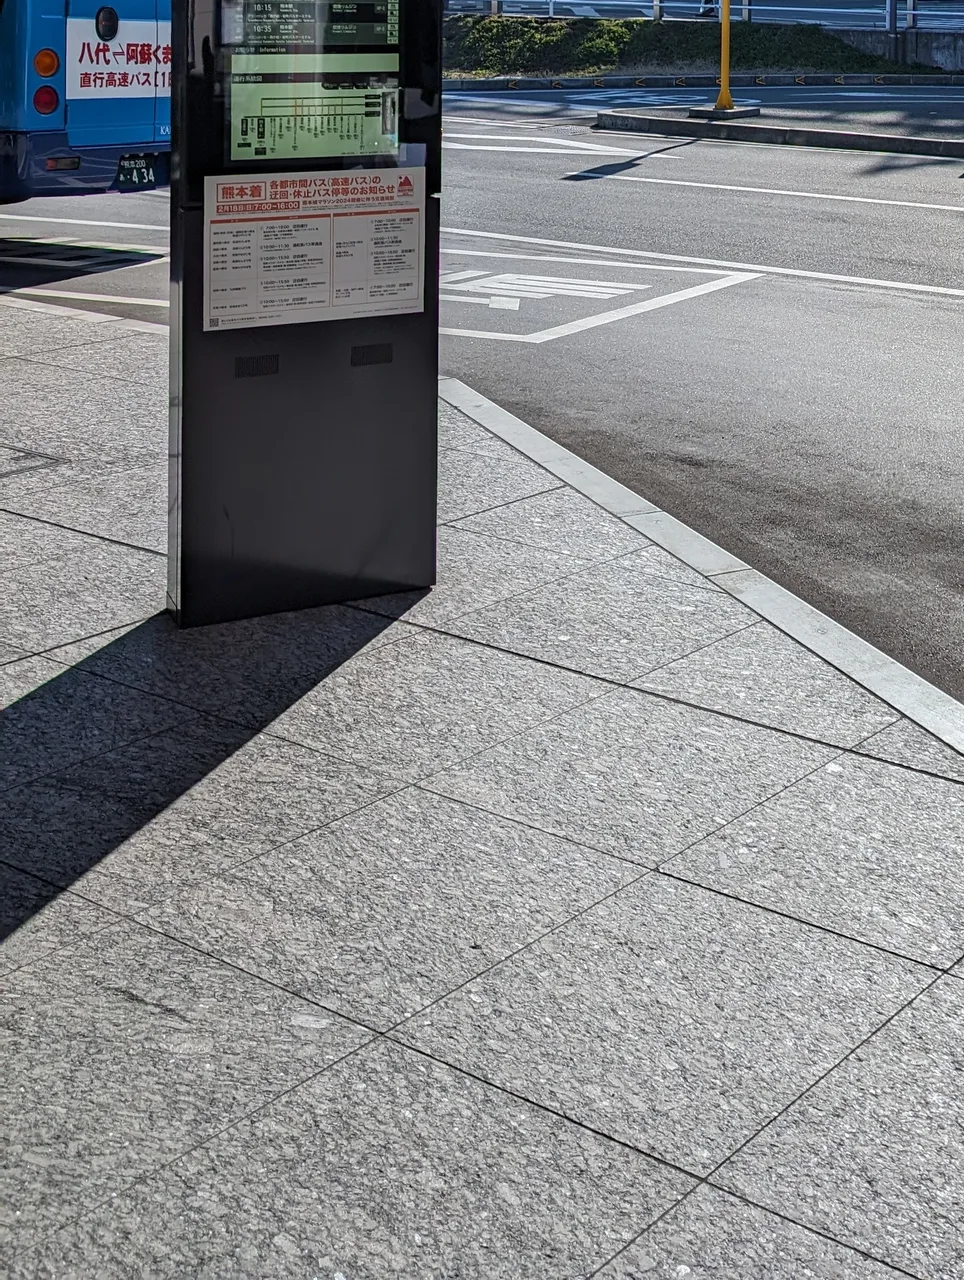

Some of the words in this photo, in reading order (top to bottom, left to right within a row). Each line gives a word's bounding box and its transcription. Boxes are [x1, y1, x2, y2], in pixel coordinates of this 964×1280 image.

[78, 42, 111, 65] 八代
[222, 185, 262, 199] 熊本着
